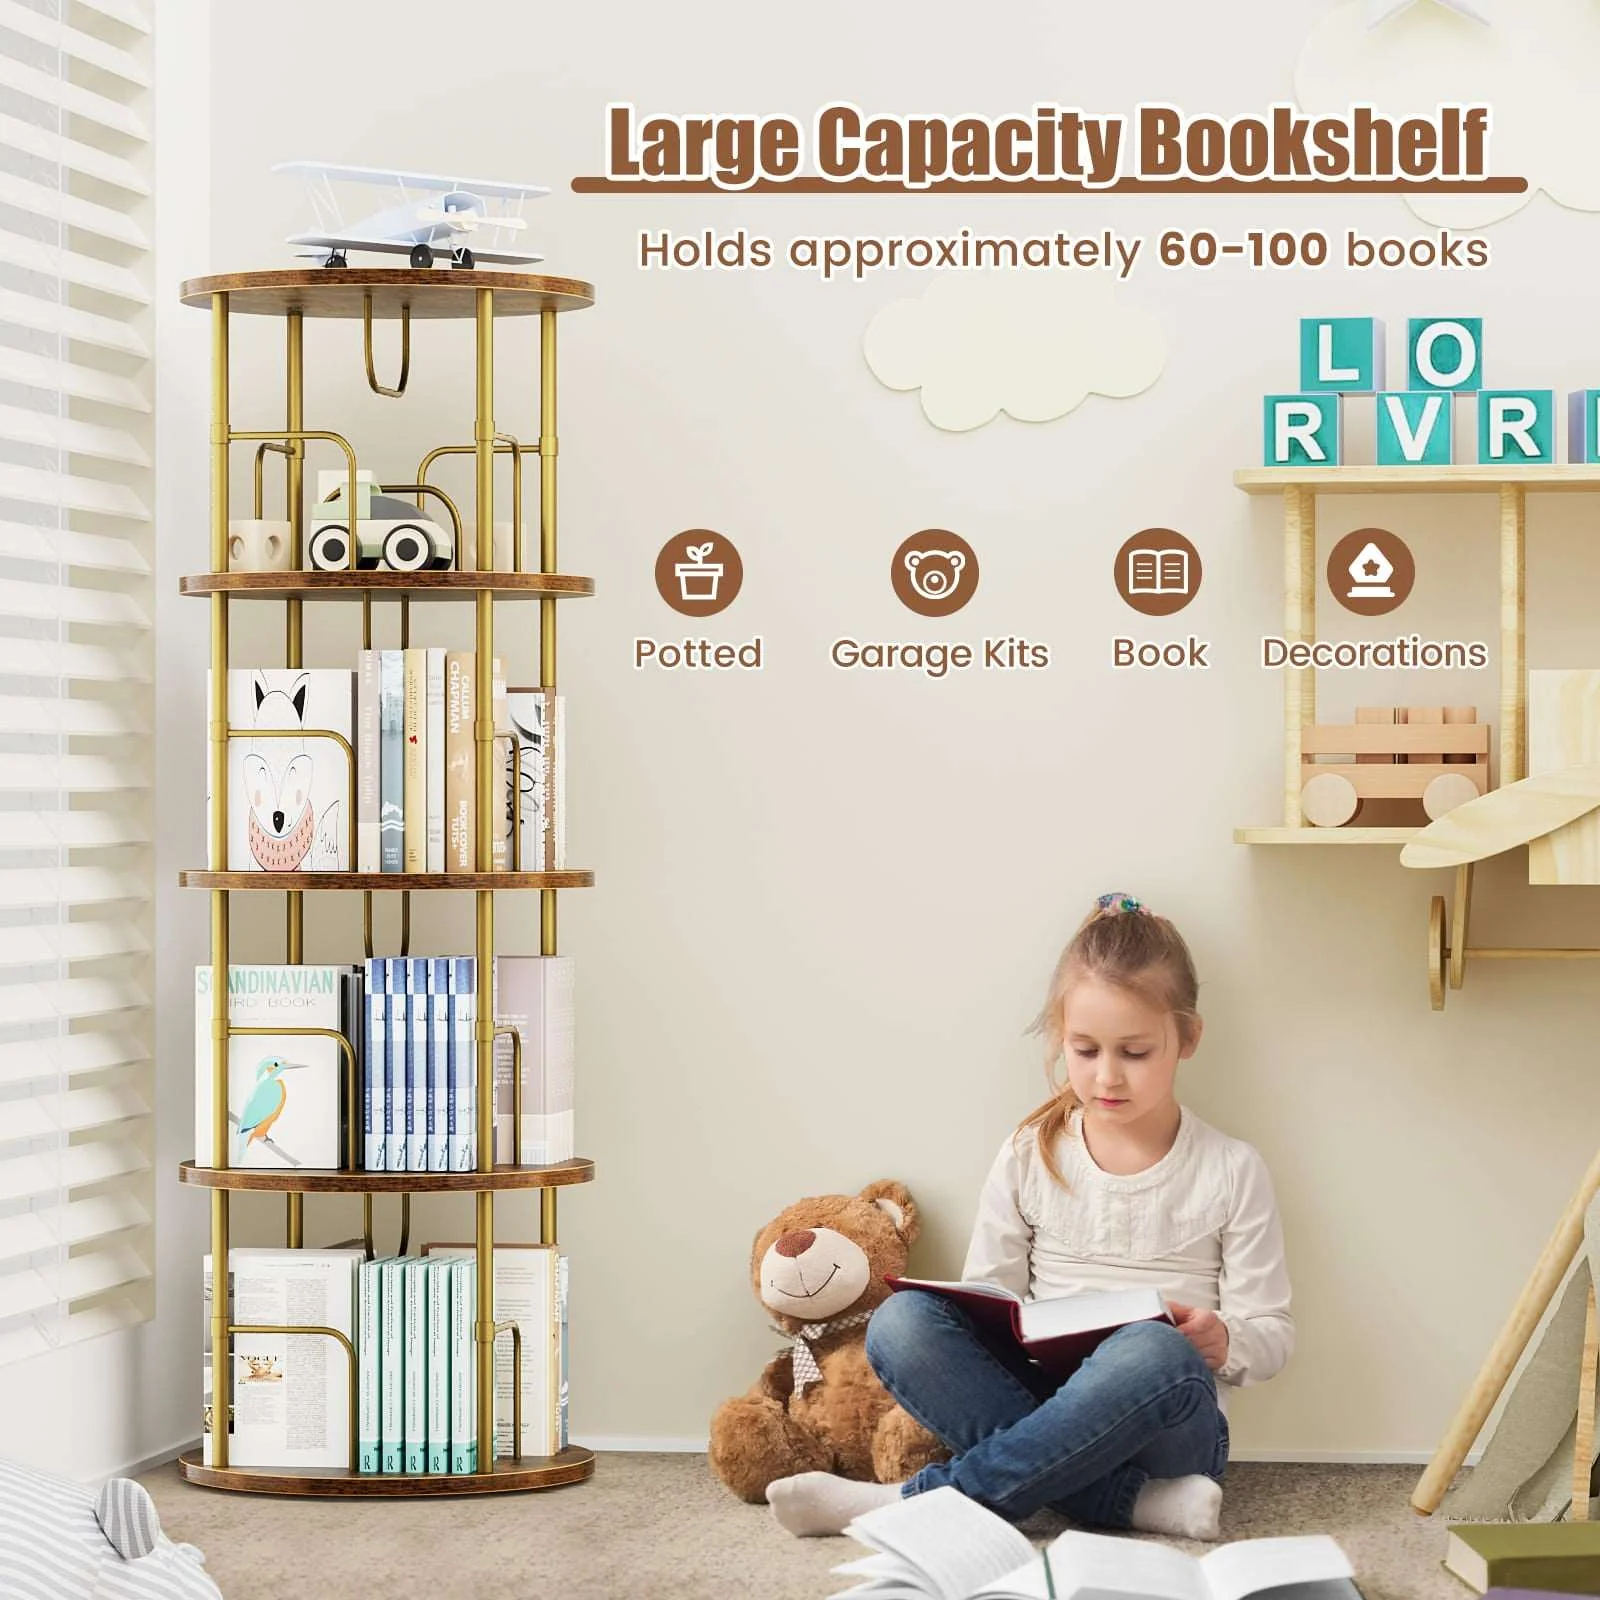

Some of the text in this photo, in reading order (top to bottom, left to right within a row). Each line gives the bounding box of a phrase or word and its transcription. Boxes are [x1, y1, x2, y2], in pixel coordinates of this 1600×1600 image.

[1318, 321, 1476, 388] L O
[1274, 401, 1326, 462] R
[1385, 396, 1443, 462] V
[1489, 397, 1542, 458] R
[450, 661, 460, 734] CHAPMAN
[461, 675, 471, 720] CALLUM
[459, 800, 469, 867] BOOK COVER
[197, 969, 333, 994] SANDINAVIAN
[267, 997, 316, 1009] BOOK
